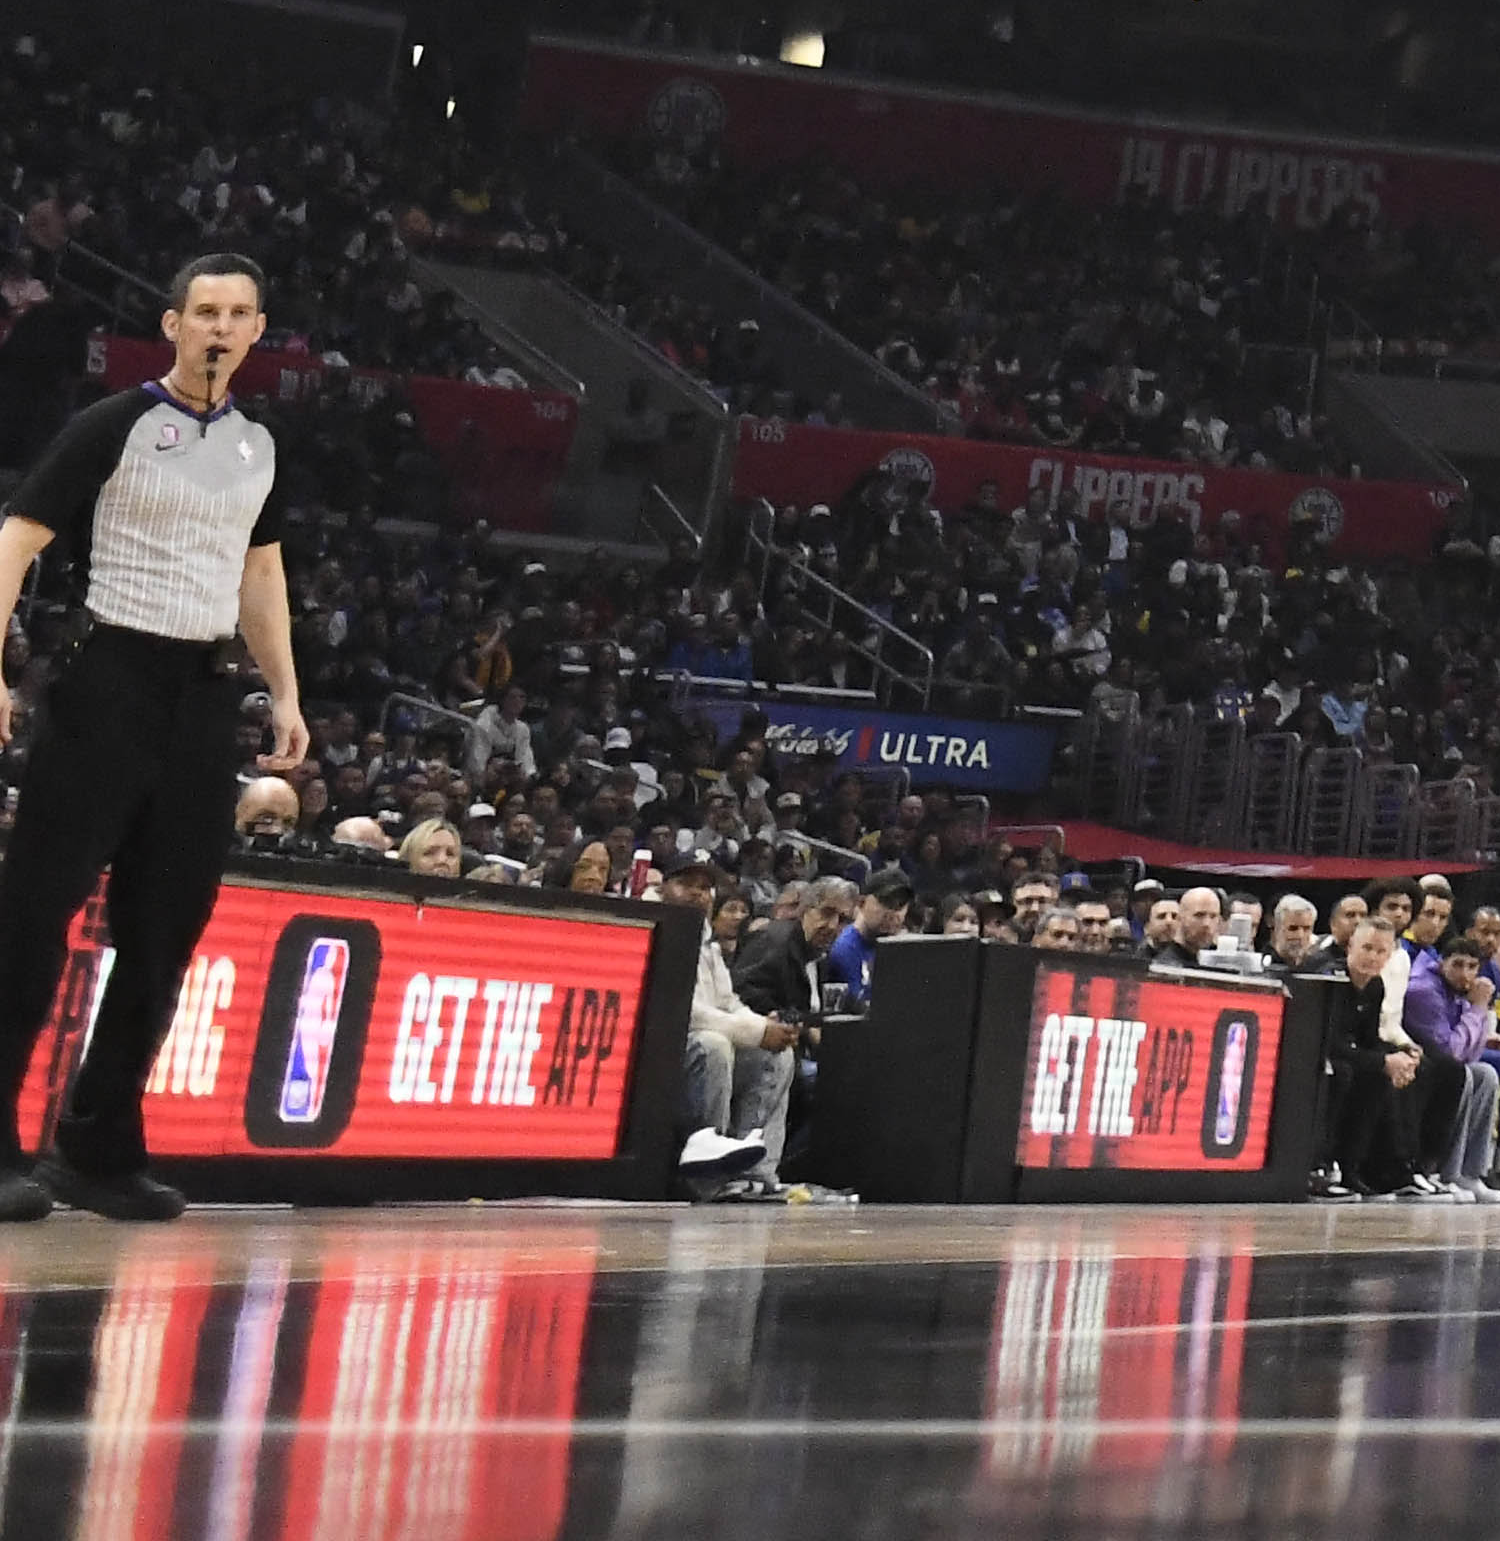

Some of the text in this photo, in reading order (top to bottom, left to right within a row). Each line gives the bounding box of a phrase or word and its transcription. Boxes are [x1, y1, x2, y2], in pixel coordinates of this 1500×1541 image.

[880, 730, 993, 770] ULTRA
[389, 972, 478, 1104] GET
[471, 977, 554, 1107] THE
[542, 985, 622, 1109] APP
